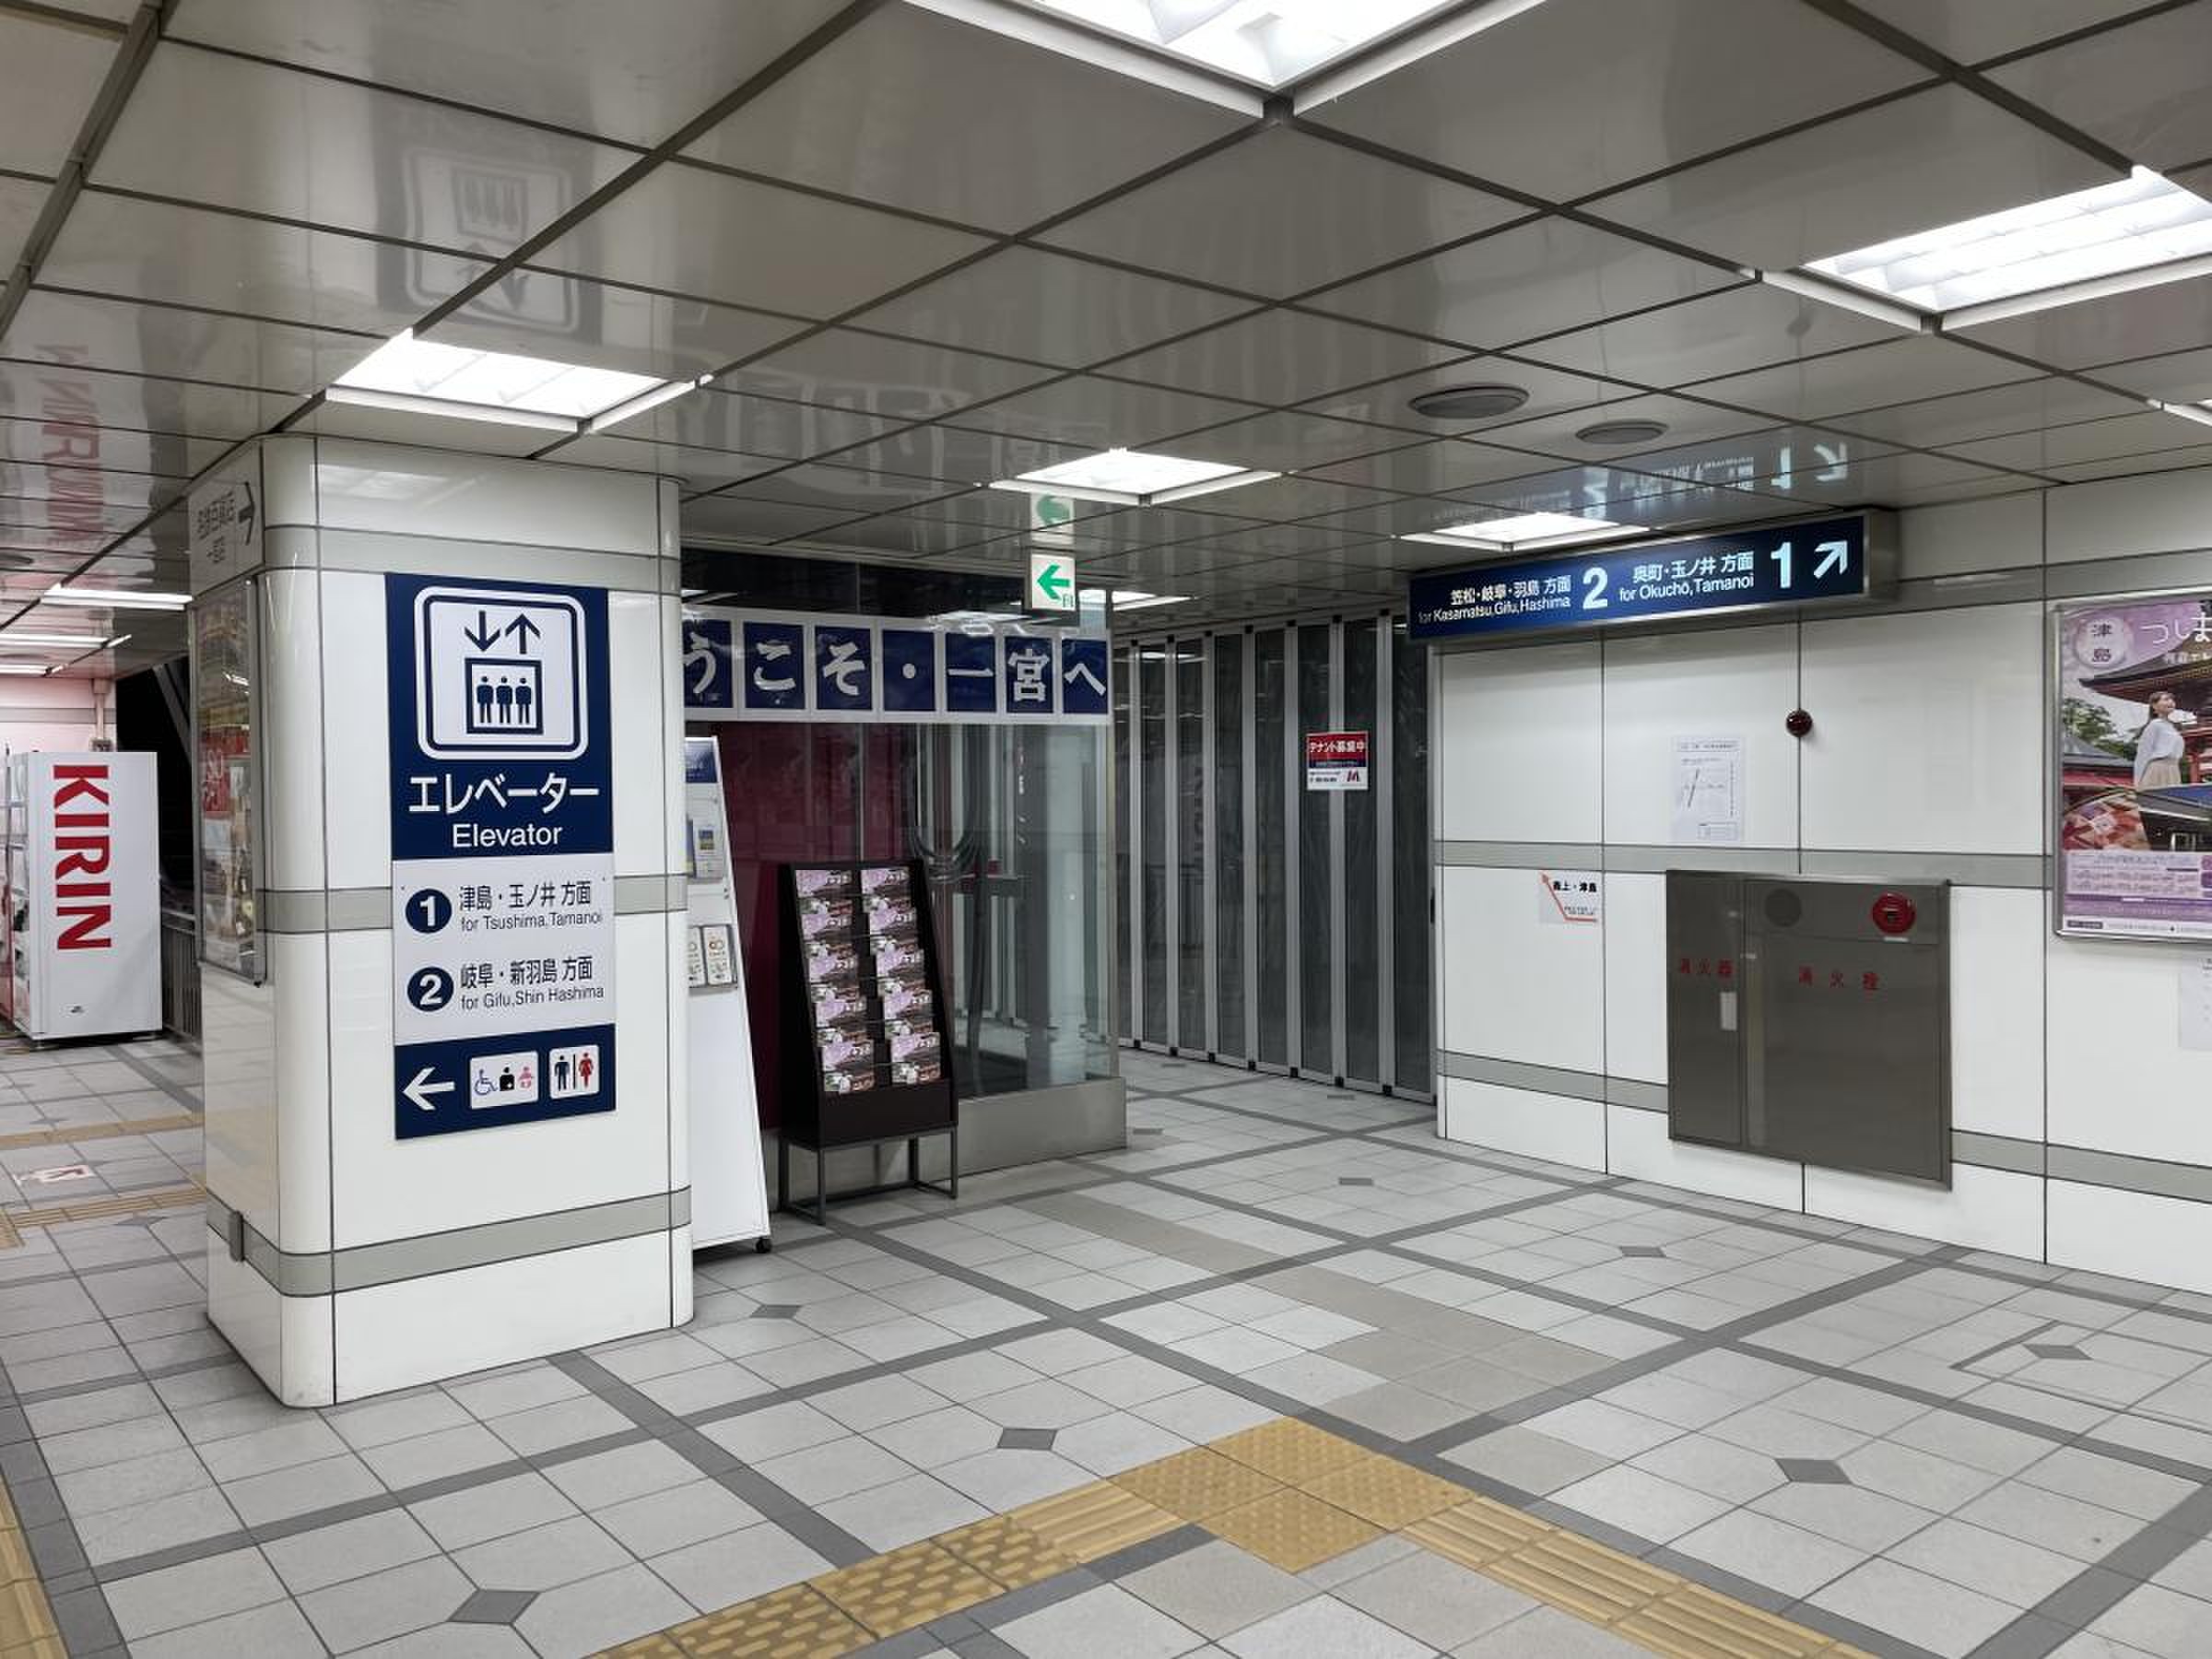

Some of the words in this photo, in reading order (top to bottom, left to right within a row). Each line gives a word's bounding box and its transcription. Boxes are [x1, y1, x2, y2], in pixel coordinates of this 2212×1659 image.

[1721, 551, 1754, 572] 方面
[1771, 542, 1792, 589] 1
[1544, 575, 1571, 594] 方面
[1583, 567, 1608, 609] 2
[1619, 587, 1635, 601] for
[409, 772, 599, 815] エレベーター
[453, 824, 563, 848] Elevator
[53, 765, 112, 950] KIRIN
[460, 882, 556, 911] 津島・玉ノ井
[561, 881, 591, 906] 方面
[461, 916, 477, 932] for
[461, 959, 558, 989] 岐阜・新羽島
[562, 956, 593, 982] 方面
[461, 994, 478, 1010] for
[548, 986, 604, 1002] Hashima
